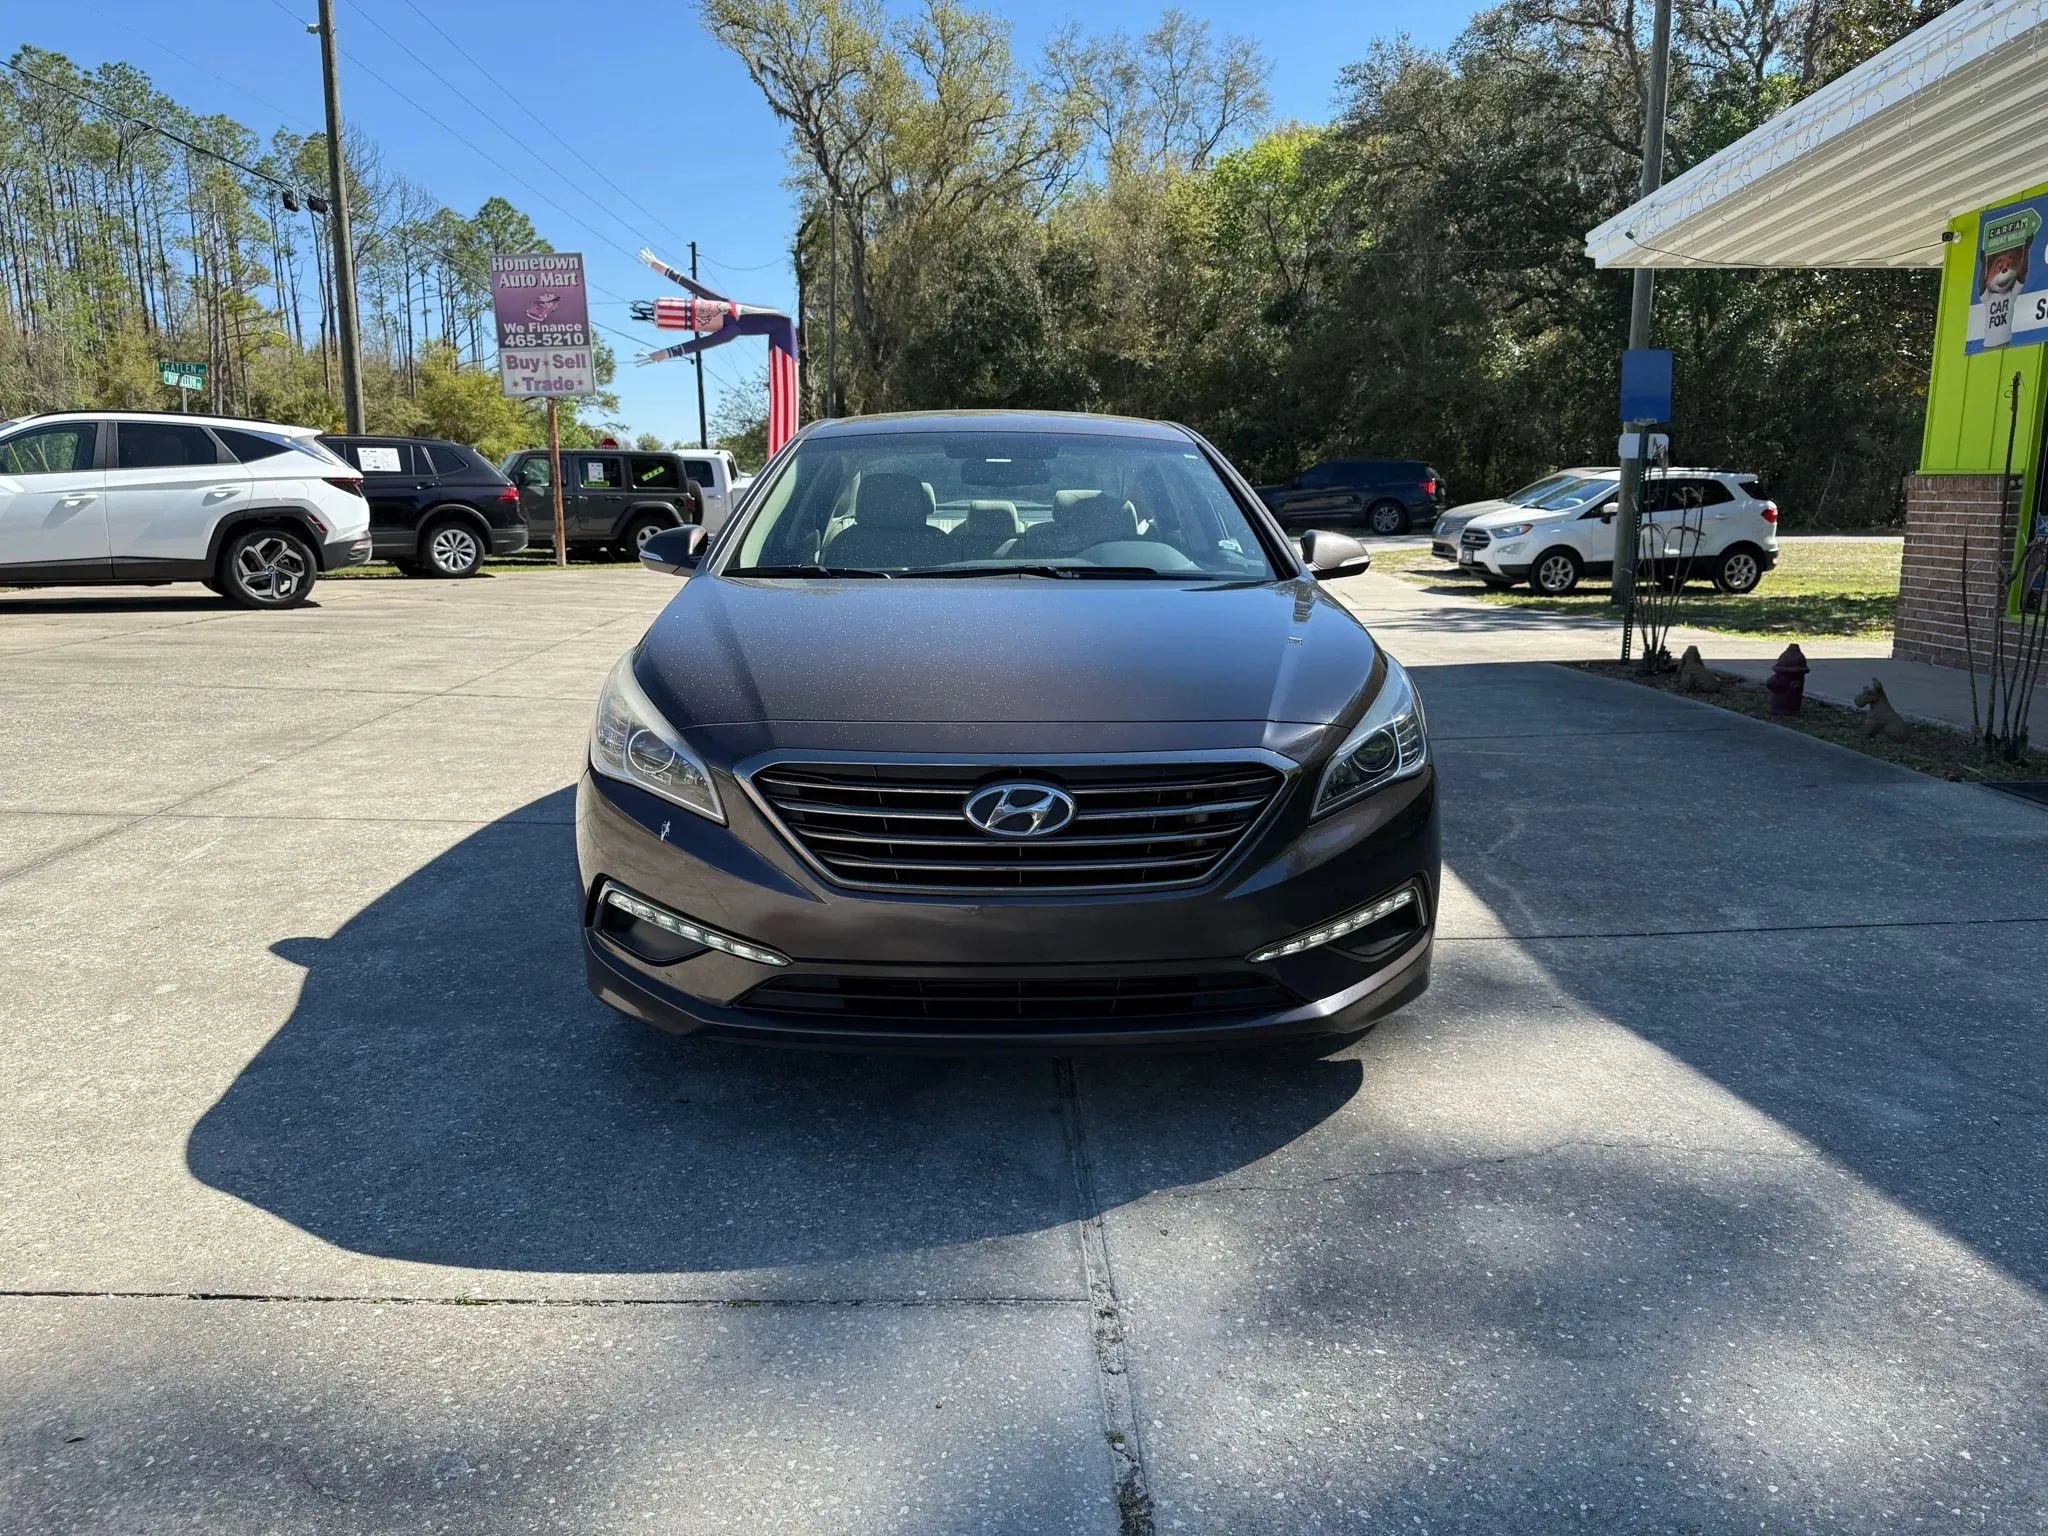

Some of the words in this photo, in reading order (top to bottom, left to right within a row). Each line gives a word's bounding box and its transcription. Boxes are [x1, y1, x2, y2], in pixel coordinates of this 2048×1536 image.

[1989, 218, 2028, 238] CARFAX
[492, 256, 580, 272] Hometown
[499, 273, 537, 288] Auto
[540, 271, 579, 287] Mart
[1990, 298, 2009, 315] CAR
[503, 323, 524, 334] We
[528, 322, 582, 333] Finance
[1989, 312, 2008, 328] FOX
[504, 333, 584, 347] 465-5210
[506, 355, 540, 373] Buy
[552, 353, 587, 369] Sell
[522, 376, 575, 391] Trade
